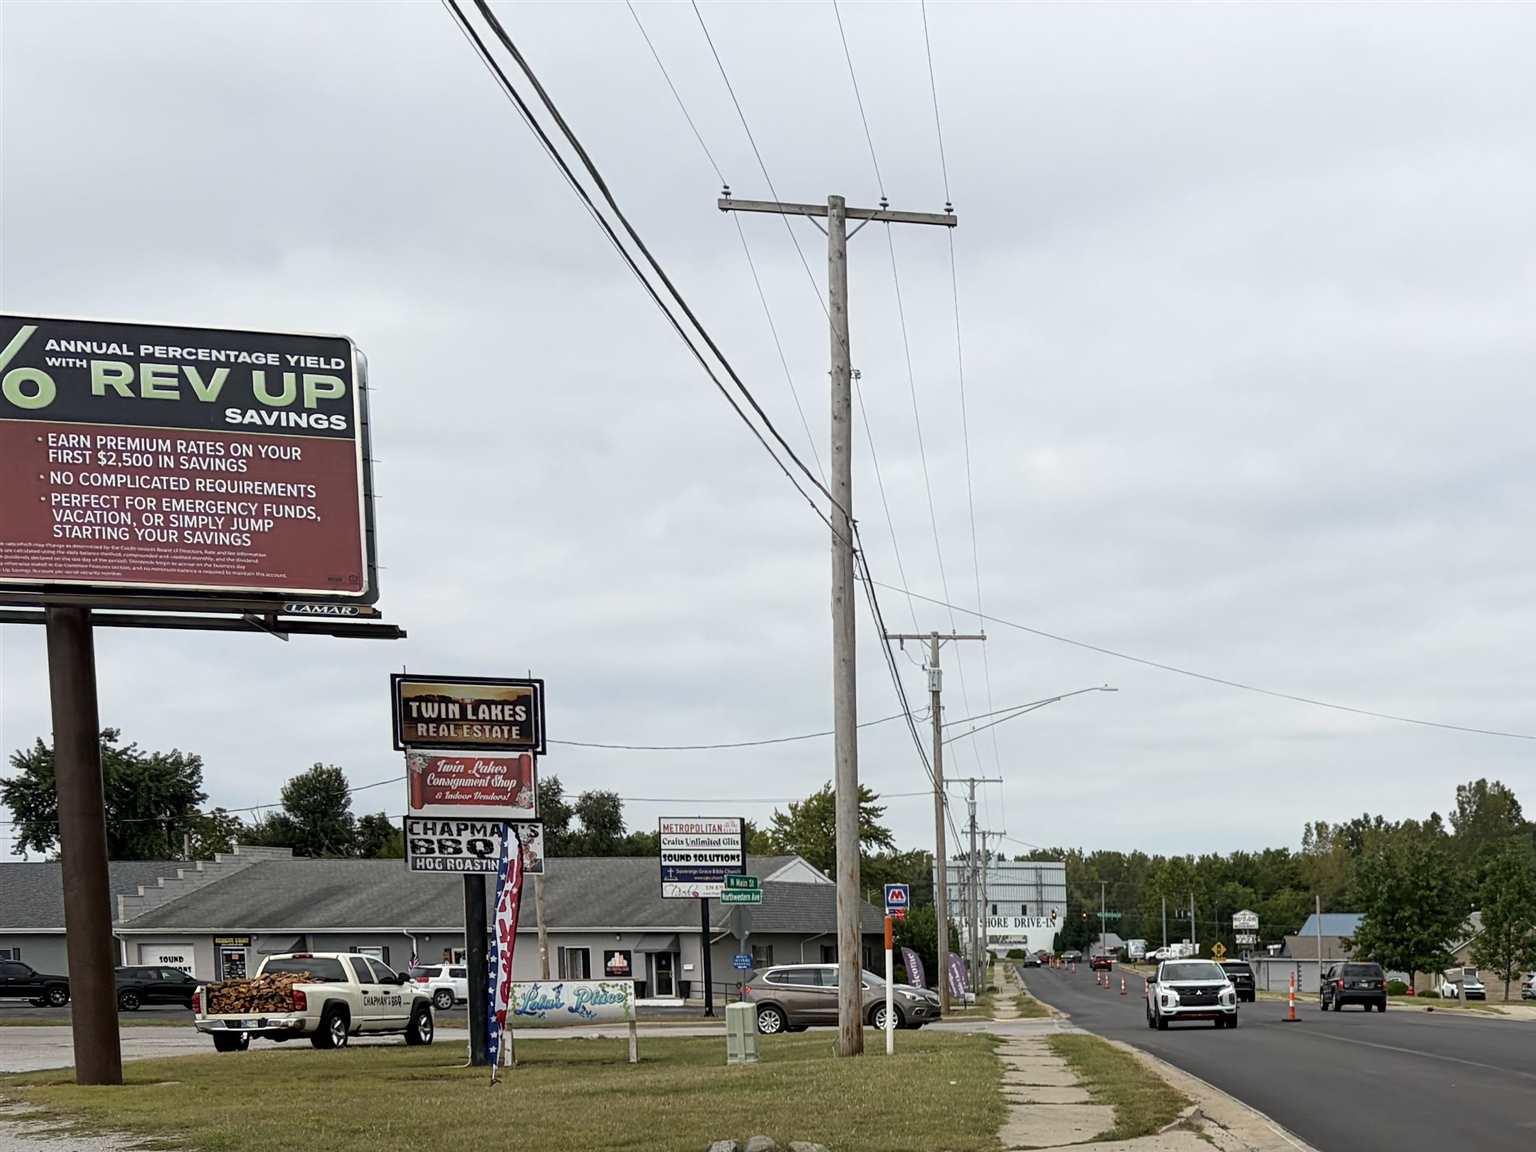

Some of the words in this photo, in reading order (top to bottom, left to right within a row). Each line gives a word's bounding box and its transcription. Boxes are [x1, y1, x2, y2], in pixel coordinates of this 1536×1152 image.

[45, 339, 134, 356] ANNUAL
[140, 345, 280, 366] PERCENTAGE
[285, 354, 345, 370] YIELD
[45, 357, 87, 369] WITH
[90, 360, 231, 402] REV
[252, 370, 346, 408] UP
[225, 407, 347, 430] SAVINGS
[48, 433, 91, 448] EARN
[97, 435, 171, 453] PREMIUM
[176, 440, 225, 456] RATES
[230, 442, 253, 457] ON
[258, 444, 302, 461] YOUR
[48, 449, 92, 464] FIRST
[97, 450, 153, 468] $2,500
[158, 455, 174, 469] IN
[180, 455, 247, 473] SAVINGS
[50, 471, 74, 485] NO
[79, 472, 190, 491] COMPLICATED
[195, 478, 316, 498] REQUIREMENTS
[51, 493, 120, 509] PERFECT
[125, 496, 156, 511] FOR
[162, 498, 258, 516] EMERGENCY
[263, 503, 320, 522] FUNDS,
[52, 508, 137, 527] VACATION,
[141, 513, 164, 527] OR
[169, 514, 225, 529] SIMPLY
[230, 517, 274, 532] JUMP
[53, 524, 130, 540] STARTING
[134, 528, 178, 543] YOUR
[184, 530, 252, 547] SAVINGS
[290, 604, 352, 616] LAMAR
[409, 701, 460, 719] TWIN
[466, 703, 527, 721] LAKES
[417, 723, 458, 737] REAL
[463, 724, 521, 739] ESTATE
[437, 760, 464, 774] Twin
[468, 760, 507, 777] Lakes
[427, 773, 489, 789] Consignment
[491, 774, 517, 791] Shop
[445, 791, 472, 800] Indoor
[474, 791, 510, 801] Vendors!
[662, 824, 723, 833] METROPOLITAN
[410, 838, 494, 858] BBQ
[662, 838, 684, 846] Crafts
[685, 838, 720, 846] Unlimited
[722, 838, 739, 846] Gifts
[416, 858, 443, 870] HOG
[447, 859, 499, 871] ROASTIN
[663, 854, 691, 862] SOUND
[693, 854, 740, 862] SOLUTIONS
[736, 878, 748, 886] Main
[1014, 917, 1056, 928] DRIVE-IN
